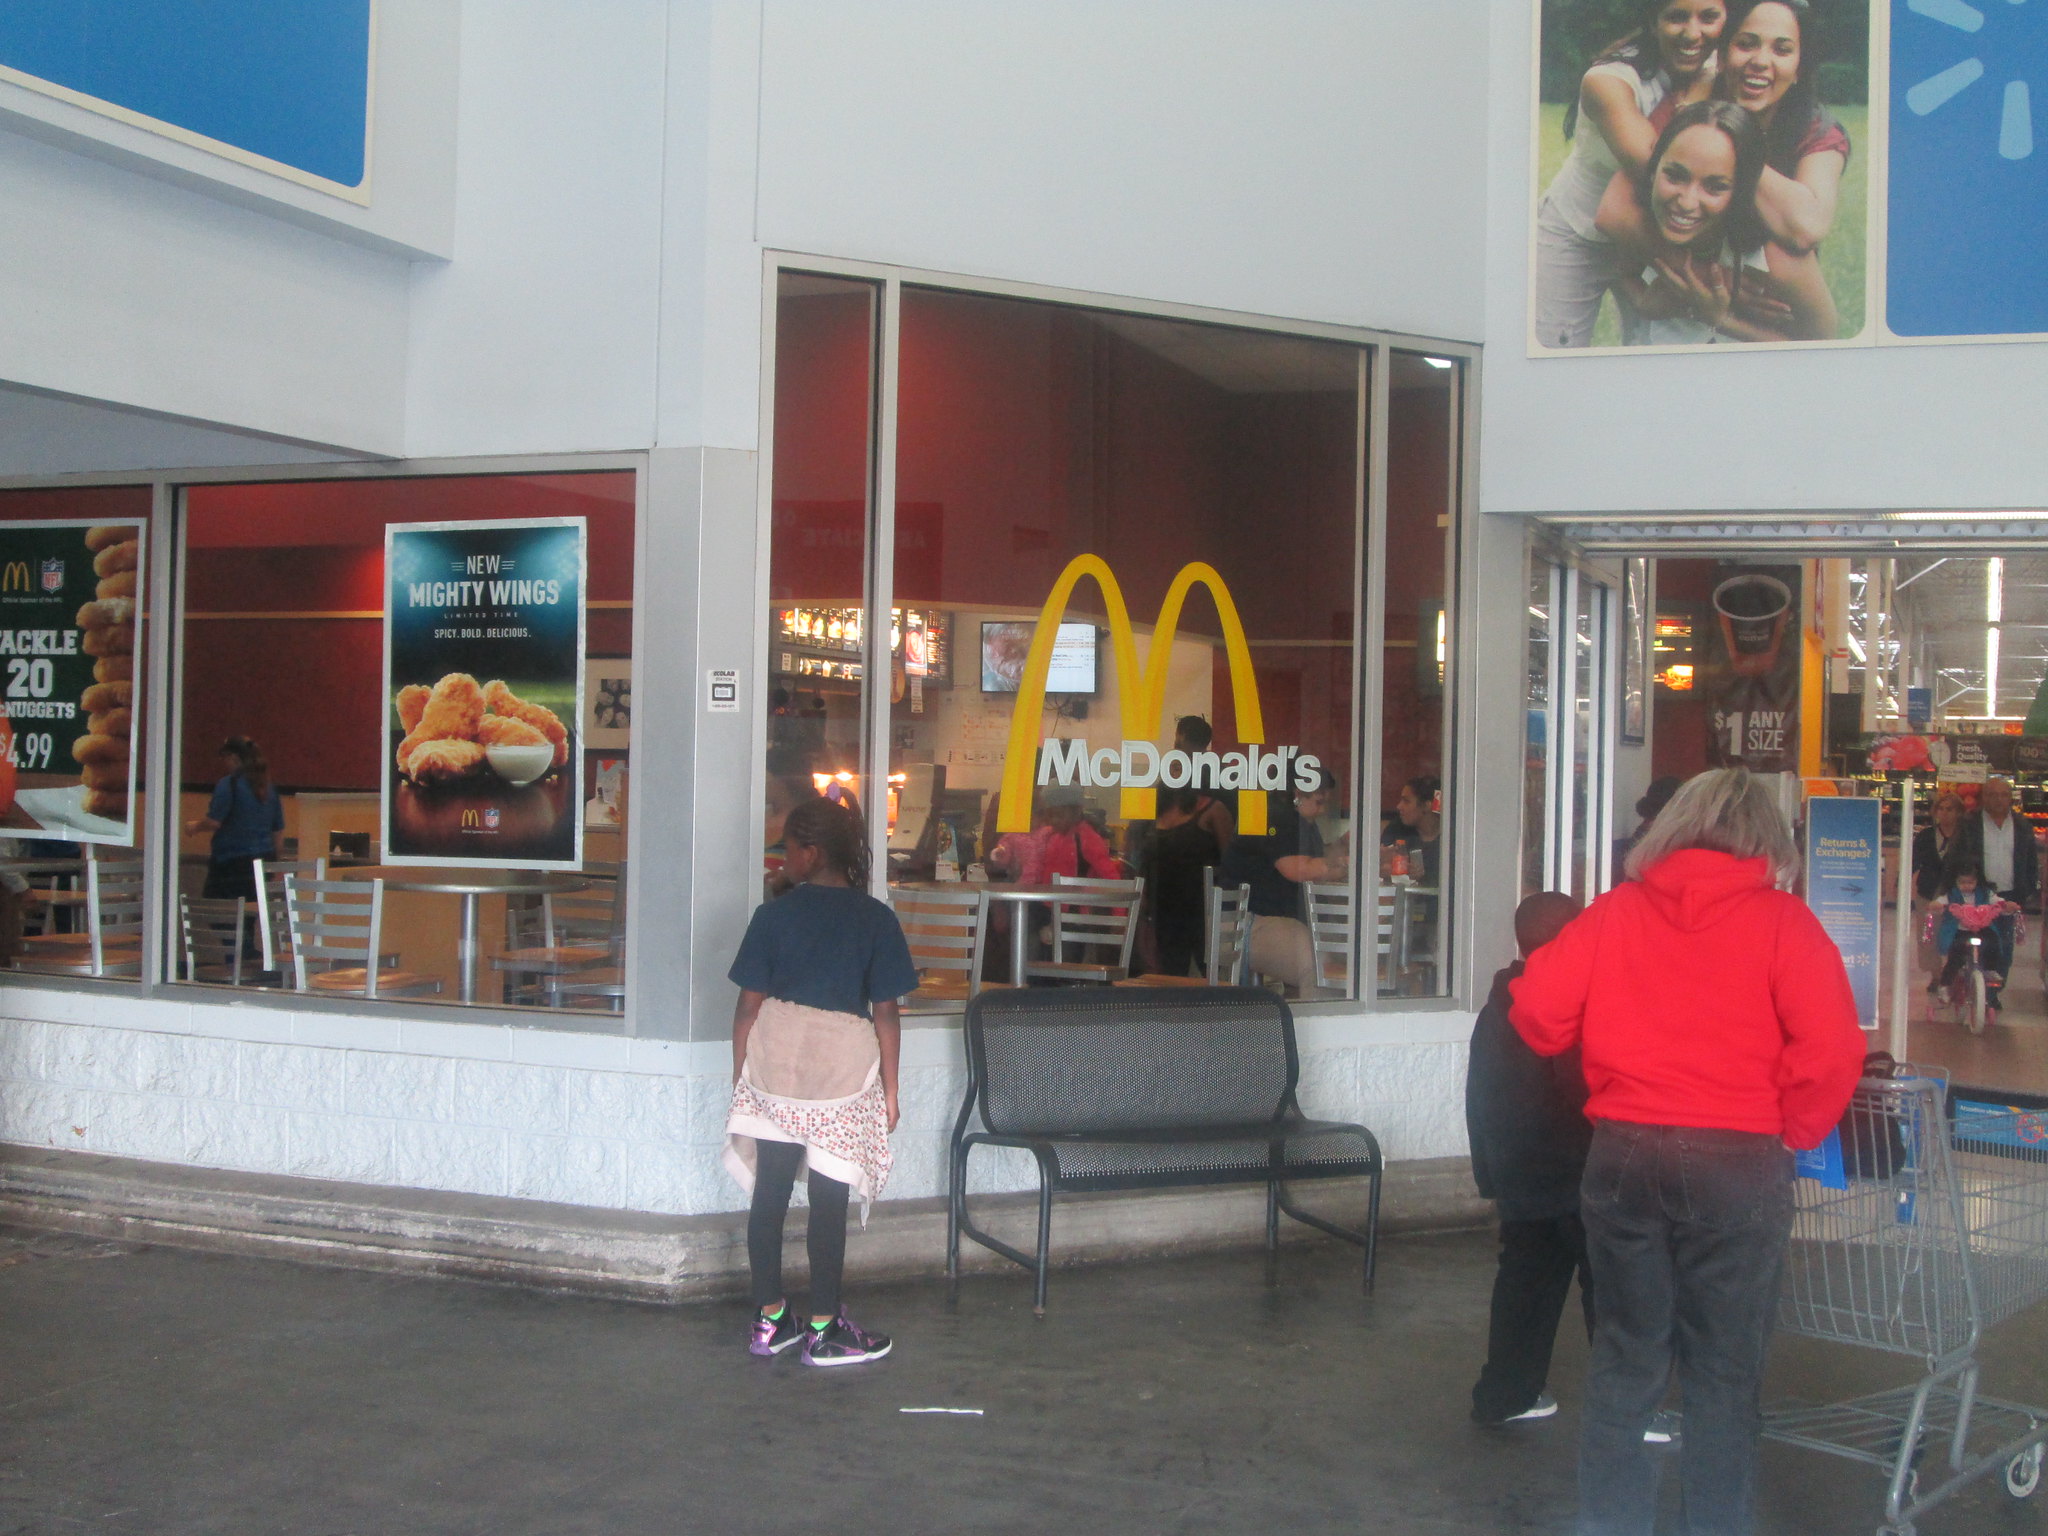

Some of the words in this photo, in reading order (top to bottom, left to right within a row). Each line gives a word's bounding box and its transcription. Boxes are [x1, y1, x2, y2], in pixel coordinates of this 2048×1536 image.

[467, 555, 500, 575] NEW
[409, 581, 485, 607] MIGHTY
[488, 580, 560, 605] WINGS
[494, 611, 519, 619] TIME
[0, 629, 78, 655] ACKLE
[487, 627, 532, 638] DELICIOUS.
[7, 658, 54, 698] 20
[1714, 710, 1743, 756] $1
[1749, 711, 1785, 728] ANY
[1748, 730, 1784, 750] SIZE
[1037, 738, 1321, 792] McDonald's
[1956, 752, 1988, 761] Quality
[1820, 837, 1857, 848] Returns
[1859, 838, 1867, 848] &
[1815, 847, 1872, 860] Exchanges?
